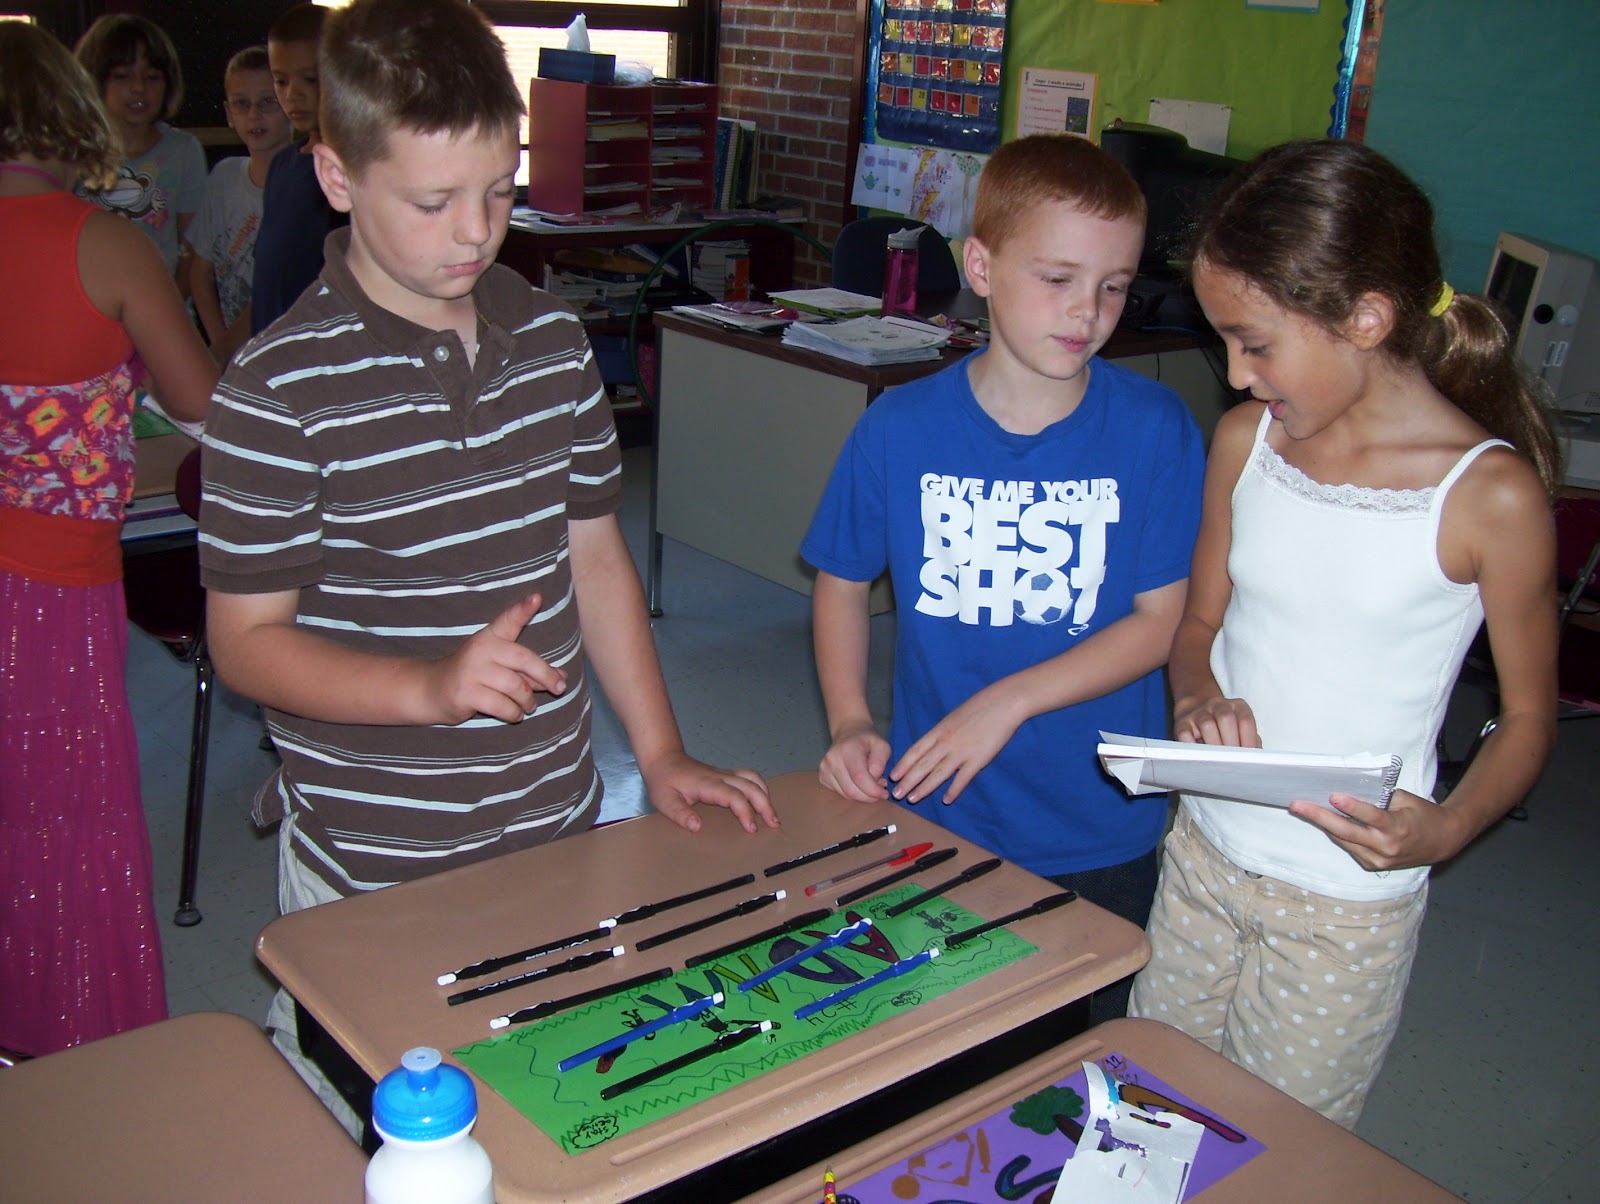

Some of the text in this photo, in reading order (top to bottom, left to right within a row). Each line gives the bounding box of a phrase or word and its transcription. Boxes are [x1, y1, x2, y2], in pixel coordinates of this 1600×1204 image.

[920, 473, 1118, 504] GIVE ME YOUR
[921, 493, 1120, 570] BEST
[914, 558, 1107, 628] SHOT
